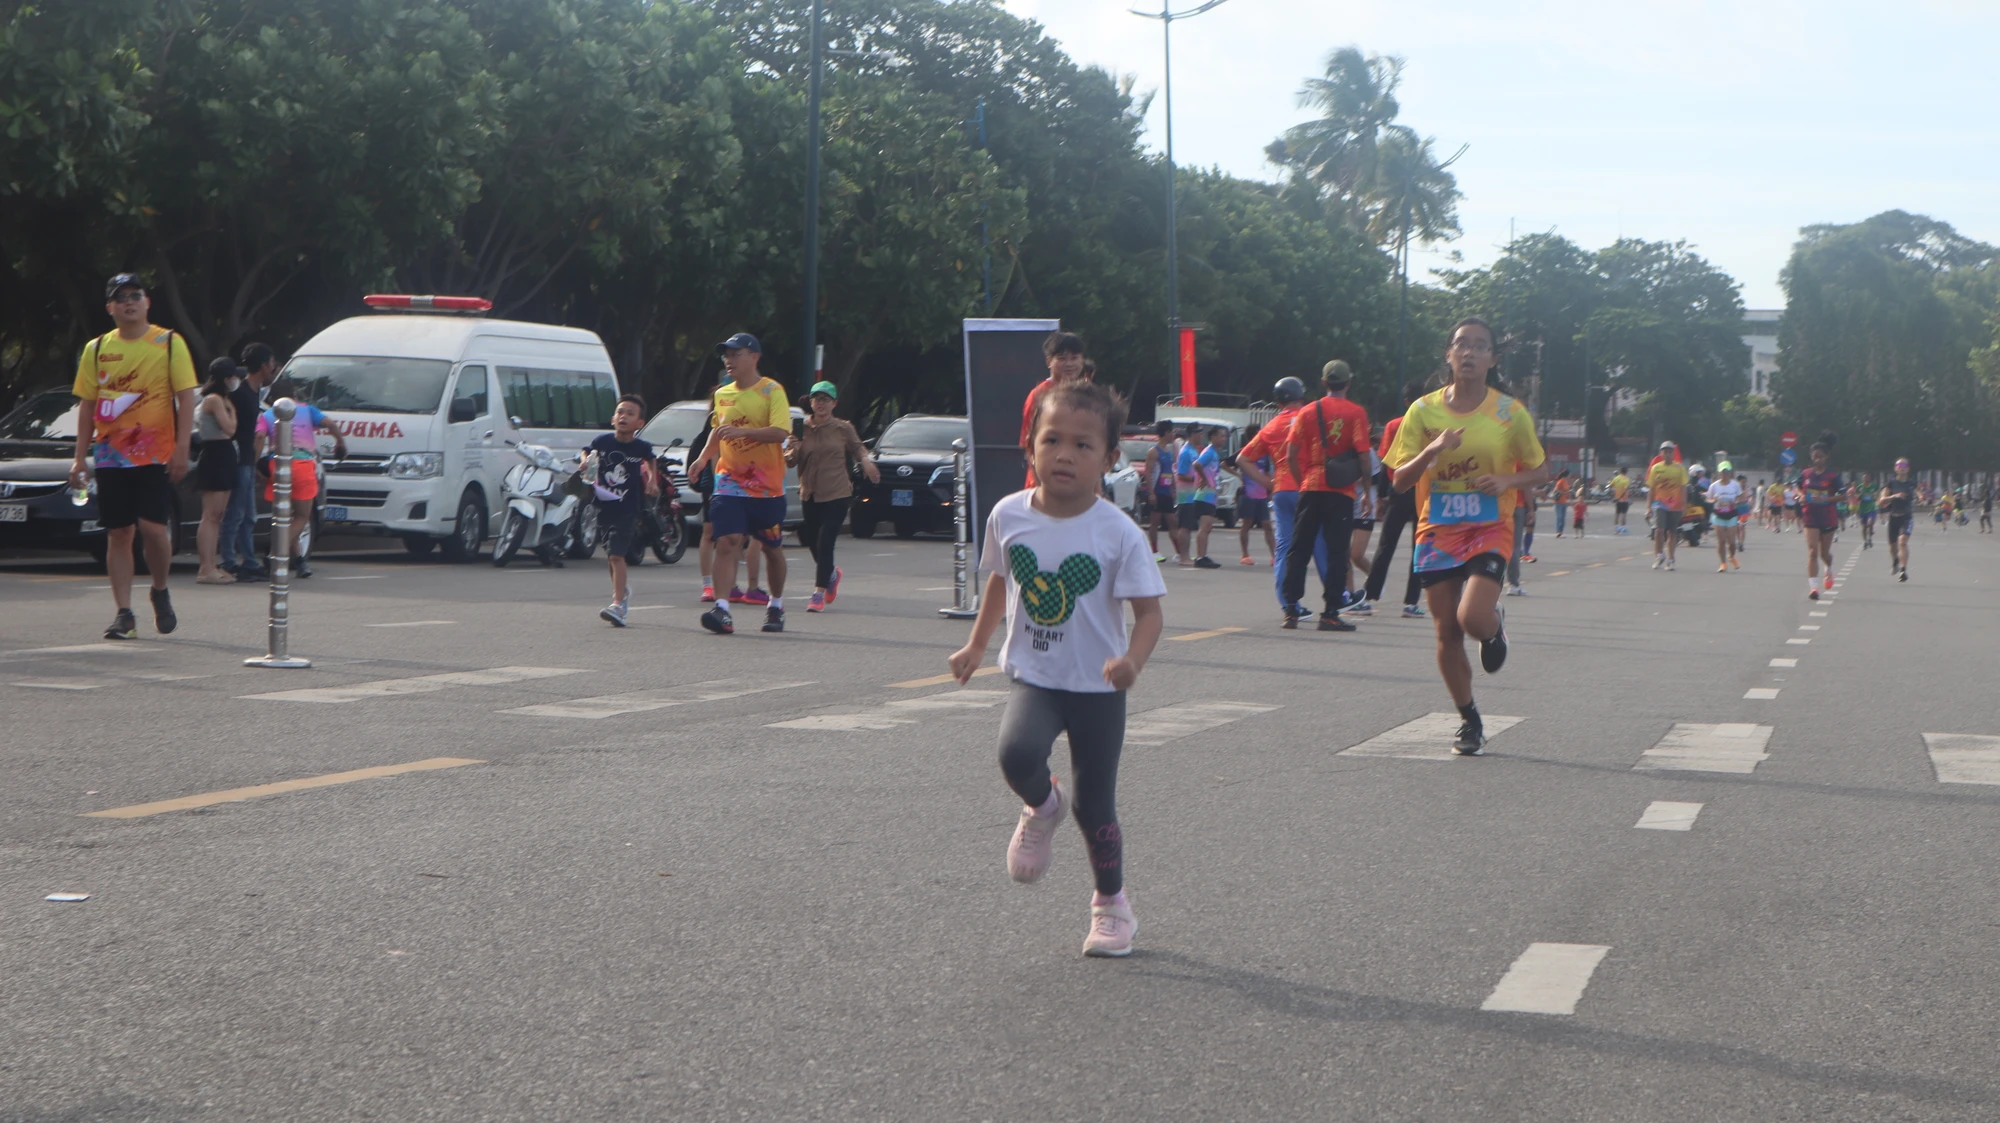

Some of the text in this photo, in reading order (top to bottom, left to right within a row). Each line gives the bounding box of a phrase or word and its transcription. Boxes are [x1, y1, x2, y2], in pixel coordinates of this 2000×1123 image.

[1441, 494, 1481, 517] 298
[1033, 627, 1064, 643] HEART
[1032, 639, 1049, 652] DID
